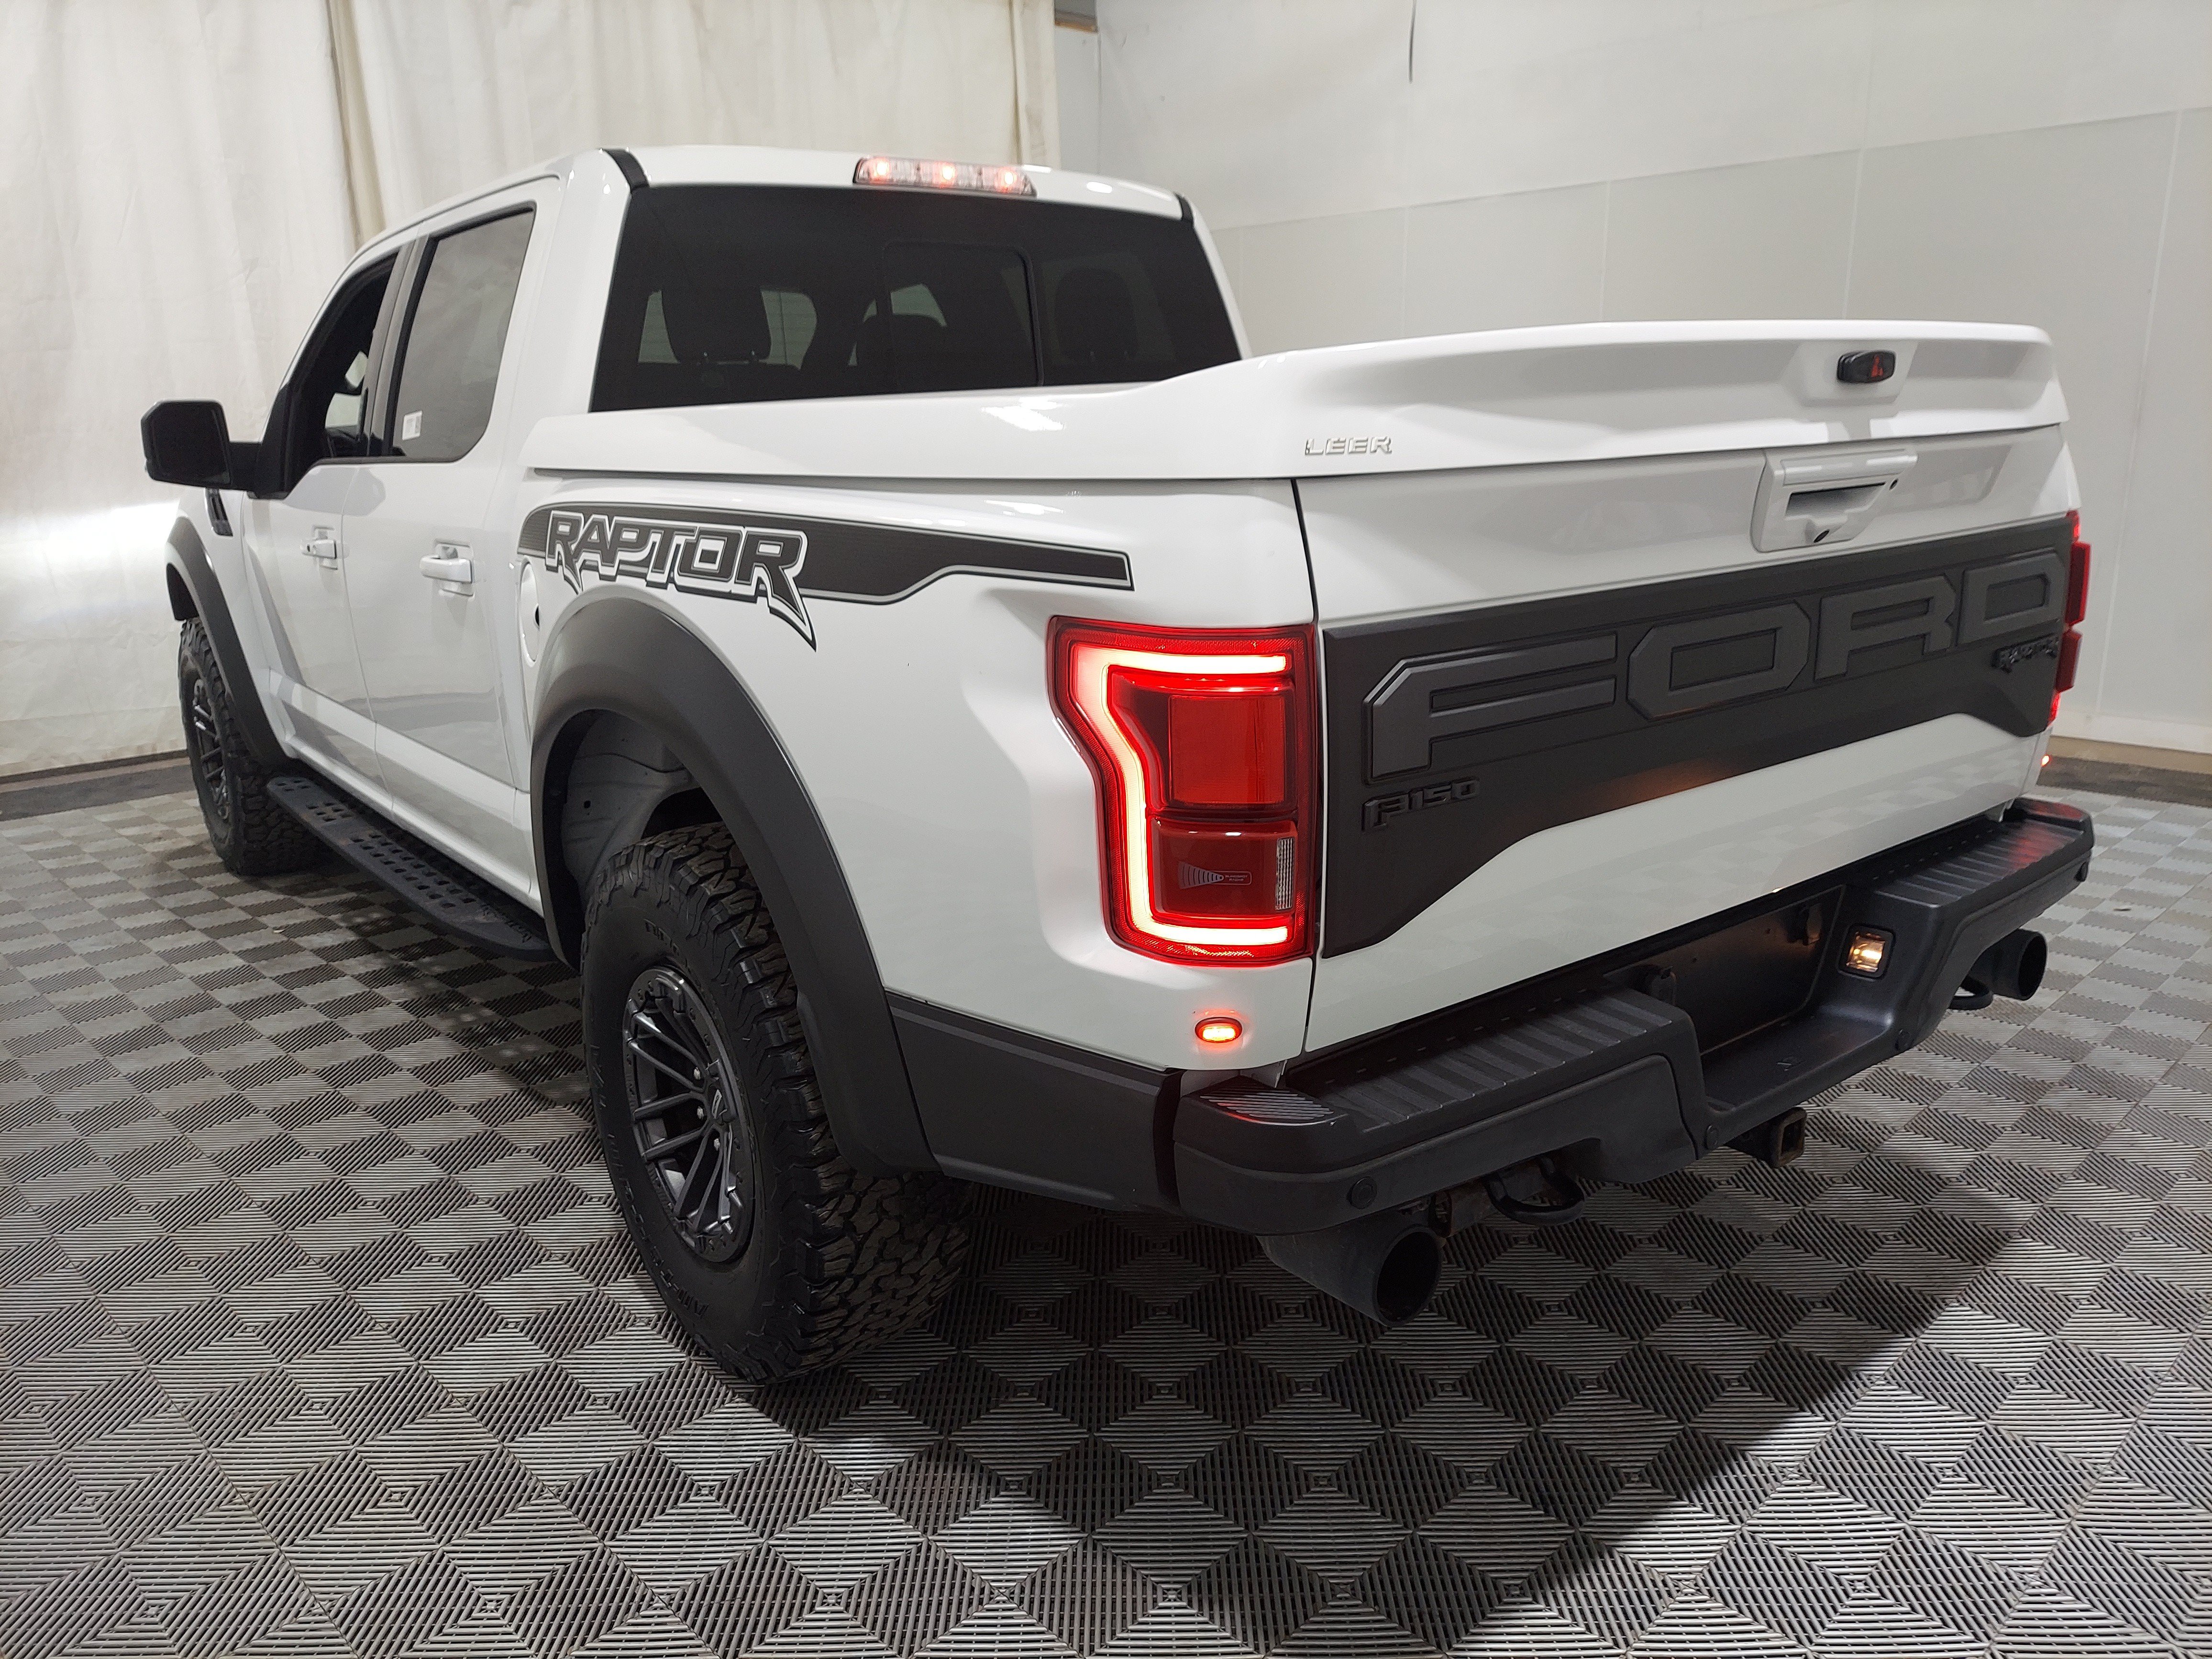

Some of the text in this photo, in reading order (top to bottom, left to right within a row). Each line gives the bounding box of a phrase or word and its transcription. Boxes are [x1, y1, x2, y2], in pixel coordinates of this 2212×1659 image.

[1305, 436, 1392, 456] LEER
[546, 510, 817, 652] RAPTOR
[1363, 550, 2066, 782] FORD
